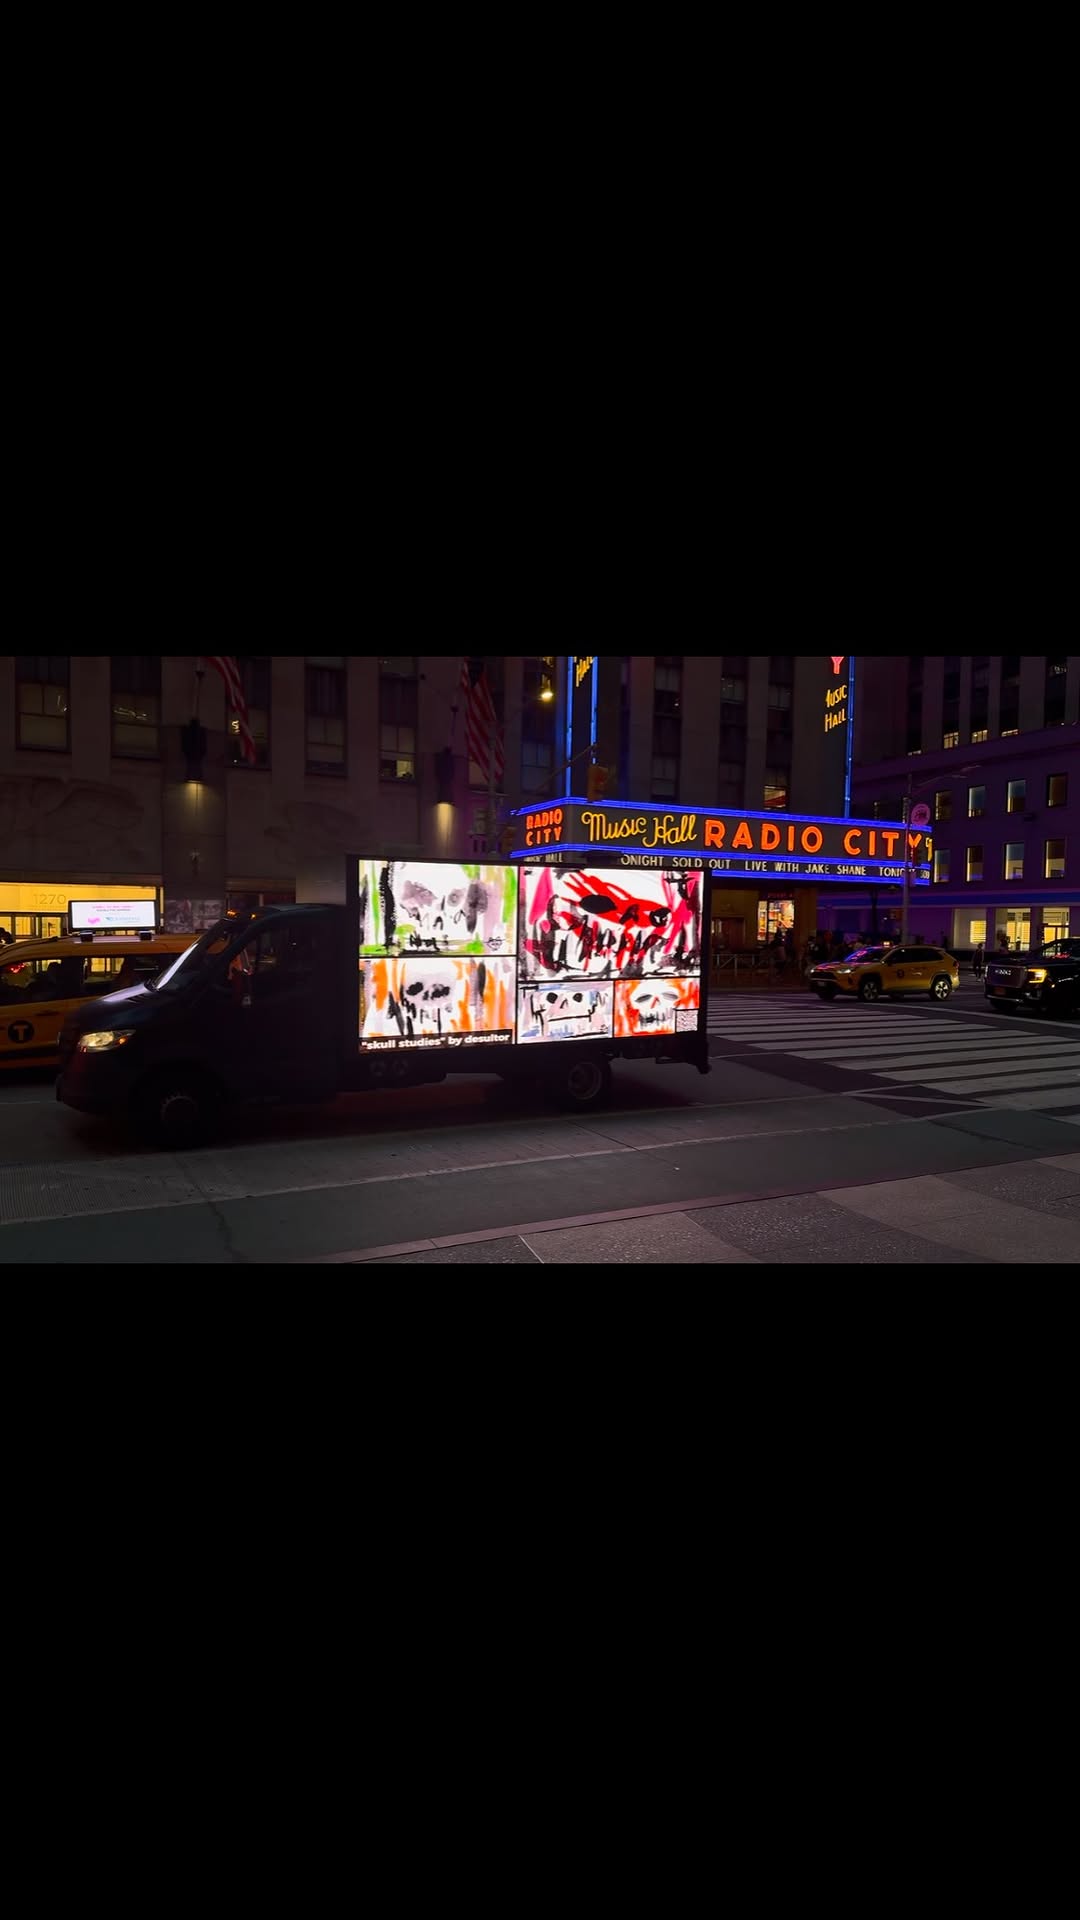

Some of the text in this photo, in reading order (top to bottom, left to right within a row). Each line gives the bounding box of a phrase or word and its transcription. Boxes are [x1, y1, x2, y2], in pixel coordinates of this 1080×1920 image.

[824, 708, 846, 732] HALL
[526, 808, 563, 829] RADIO
[525, 826, 562, 846] CITY
[704, 819, 823, 853] RADIO
[843, 828, 922, 857] CITY
[672, 856, 703, 868] SOLD
[708, 858, 731, 869] OUT
[745, 861, 767, 872] LIVE
[774, 862, 799, 873] WITH
[805, 864, 830, 874] JAKE
[837, 865, 866, 876] SHANE
[33, 893, 67, 905] 1270
[361, 1033, 510, 1050] "skull studies" by desultor
